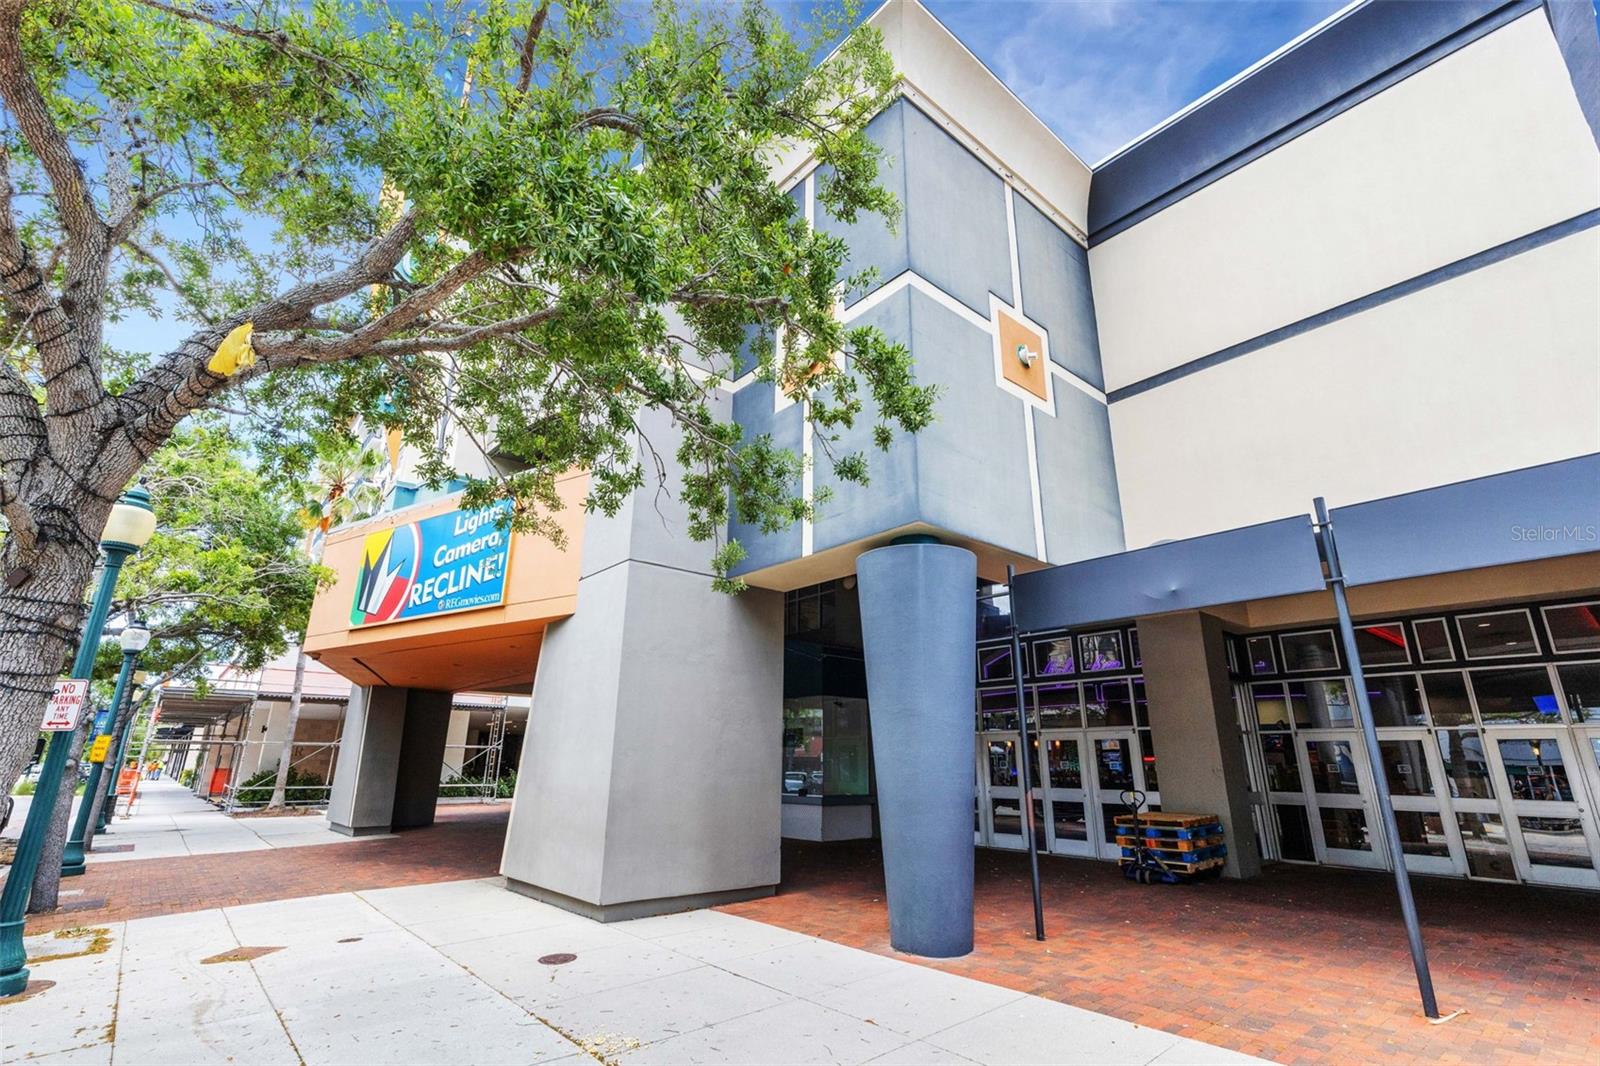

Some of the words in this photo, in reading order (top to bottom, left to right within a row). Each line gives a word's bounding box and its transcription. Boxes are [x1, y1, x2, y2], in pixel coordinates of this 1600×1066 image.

[433, 531, 503, 568] Camera,
[408, 551, 505, 609] RECLINE!
[61, 684, 76, 694] NO
[50, 695, 82, 705] PARKING
[53, 712, 69, 720] TIME
